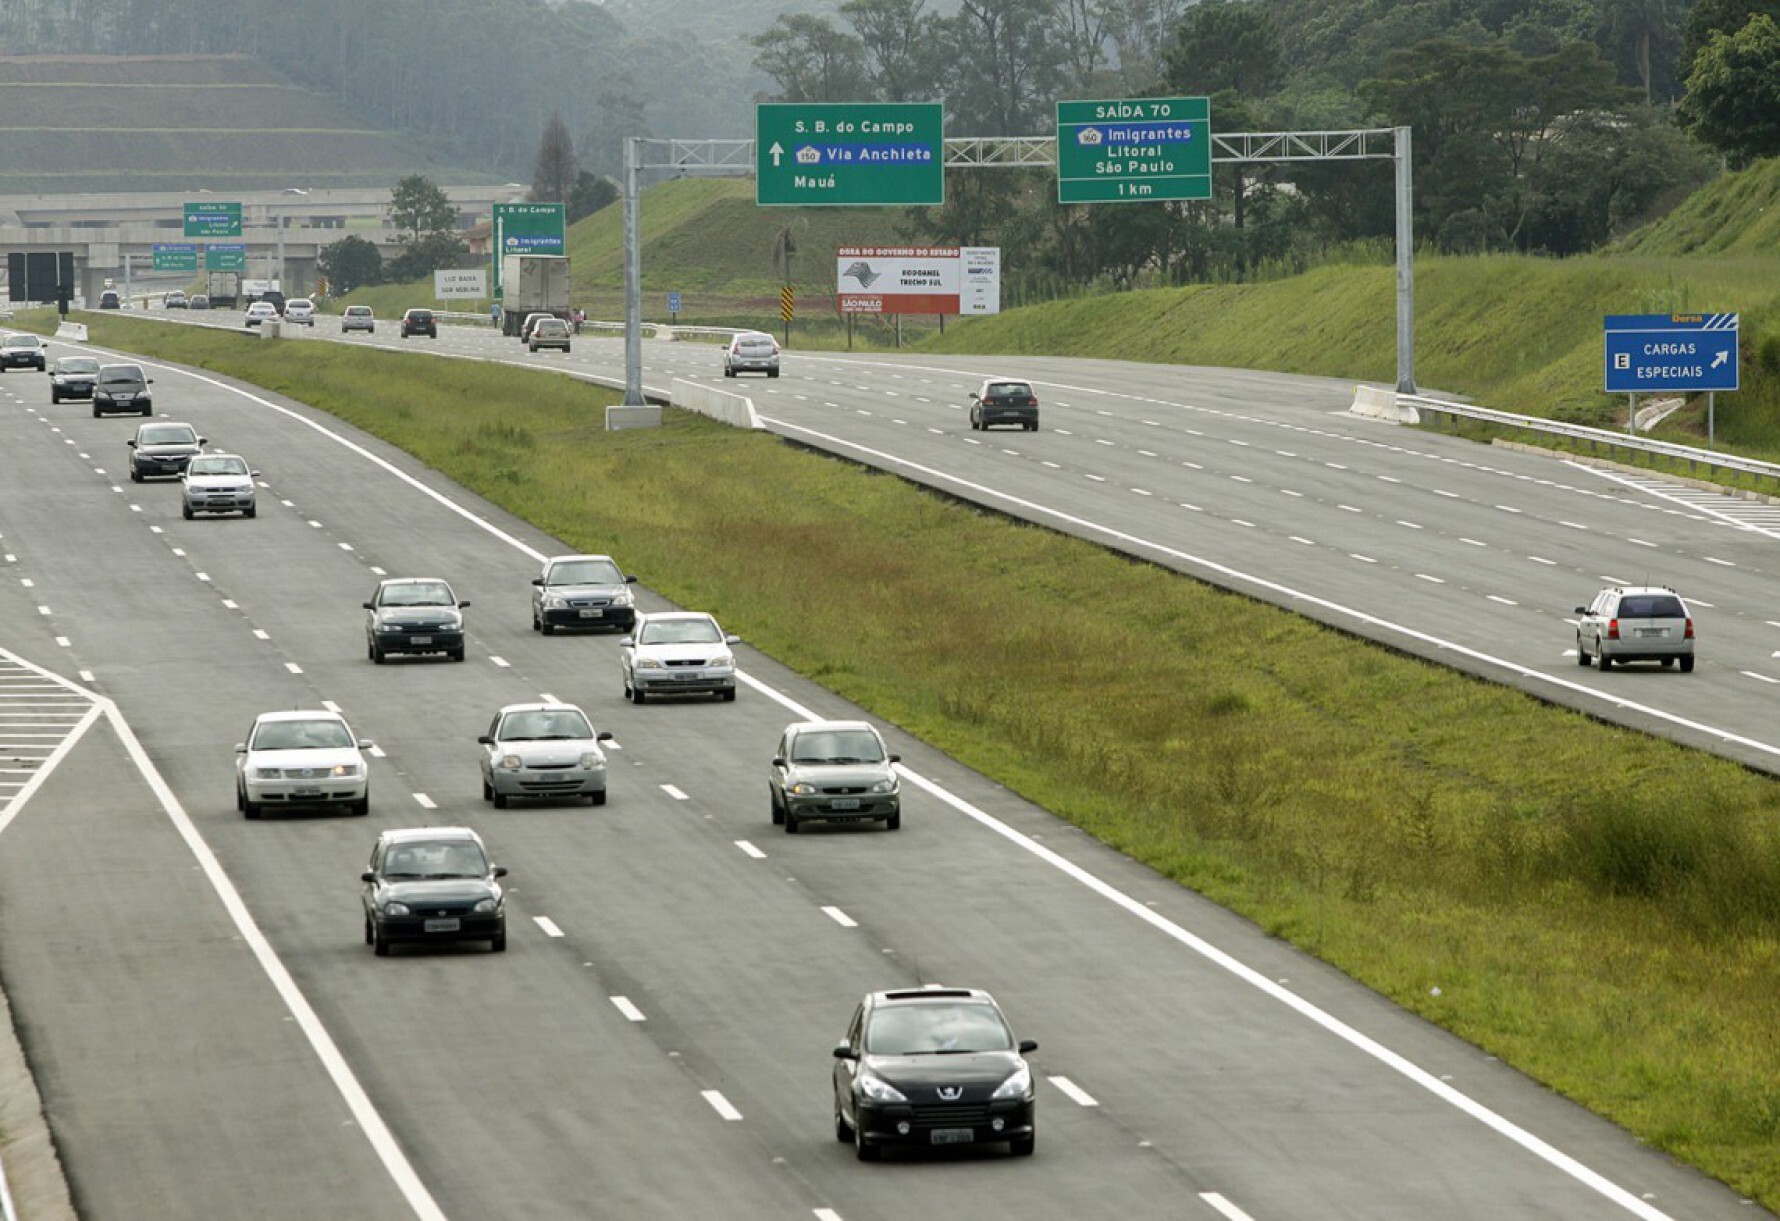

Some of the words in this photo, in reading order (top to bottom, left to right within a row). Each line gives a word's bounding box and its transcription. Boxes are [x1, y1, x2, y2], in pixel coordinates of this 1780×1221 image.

[1096, 101, 1144, 118] SAÍDA
[1151, 104, 1171, 117] 70
[795, 121, 809, 133] S.
[815, 121, 830, 133] B.
[837, 121, 854, 133] do
[861, 121, 914, 135] Campo
[1109, 128, 1192, 144] Imigrantes
[827, 148, 852, 160] Via
[859, 148, 932, 160] Anchieta
[1108, 145, 1162, 157] Litoral
[1096, 161, 1122, 174] São
[1128, 161, 1175, 173] Paulo
[794, 174, 835, 188] Mauá
[1119, 184, 1124, 196] 1
[1130, 184, 1152, 196] km
[876, 248, 914, 256] GOVERNO
[916, 248, 928, 256] DO
[902, 269, 941, 277] RODOANEL
[1644, 343, 1697, 356] CARGAS
[1637, 366, 1703, 379] ESPECIAIS
